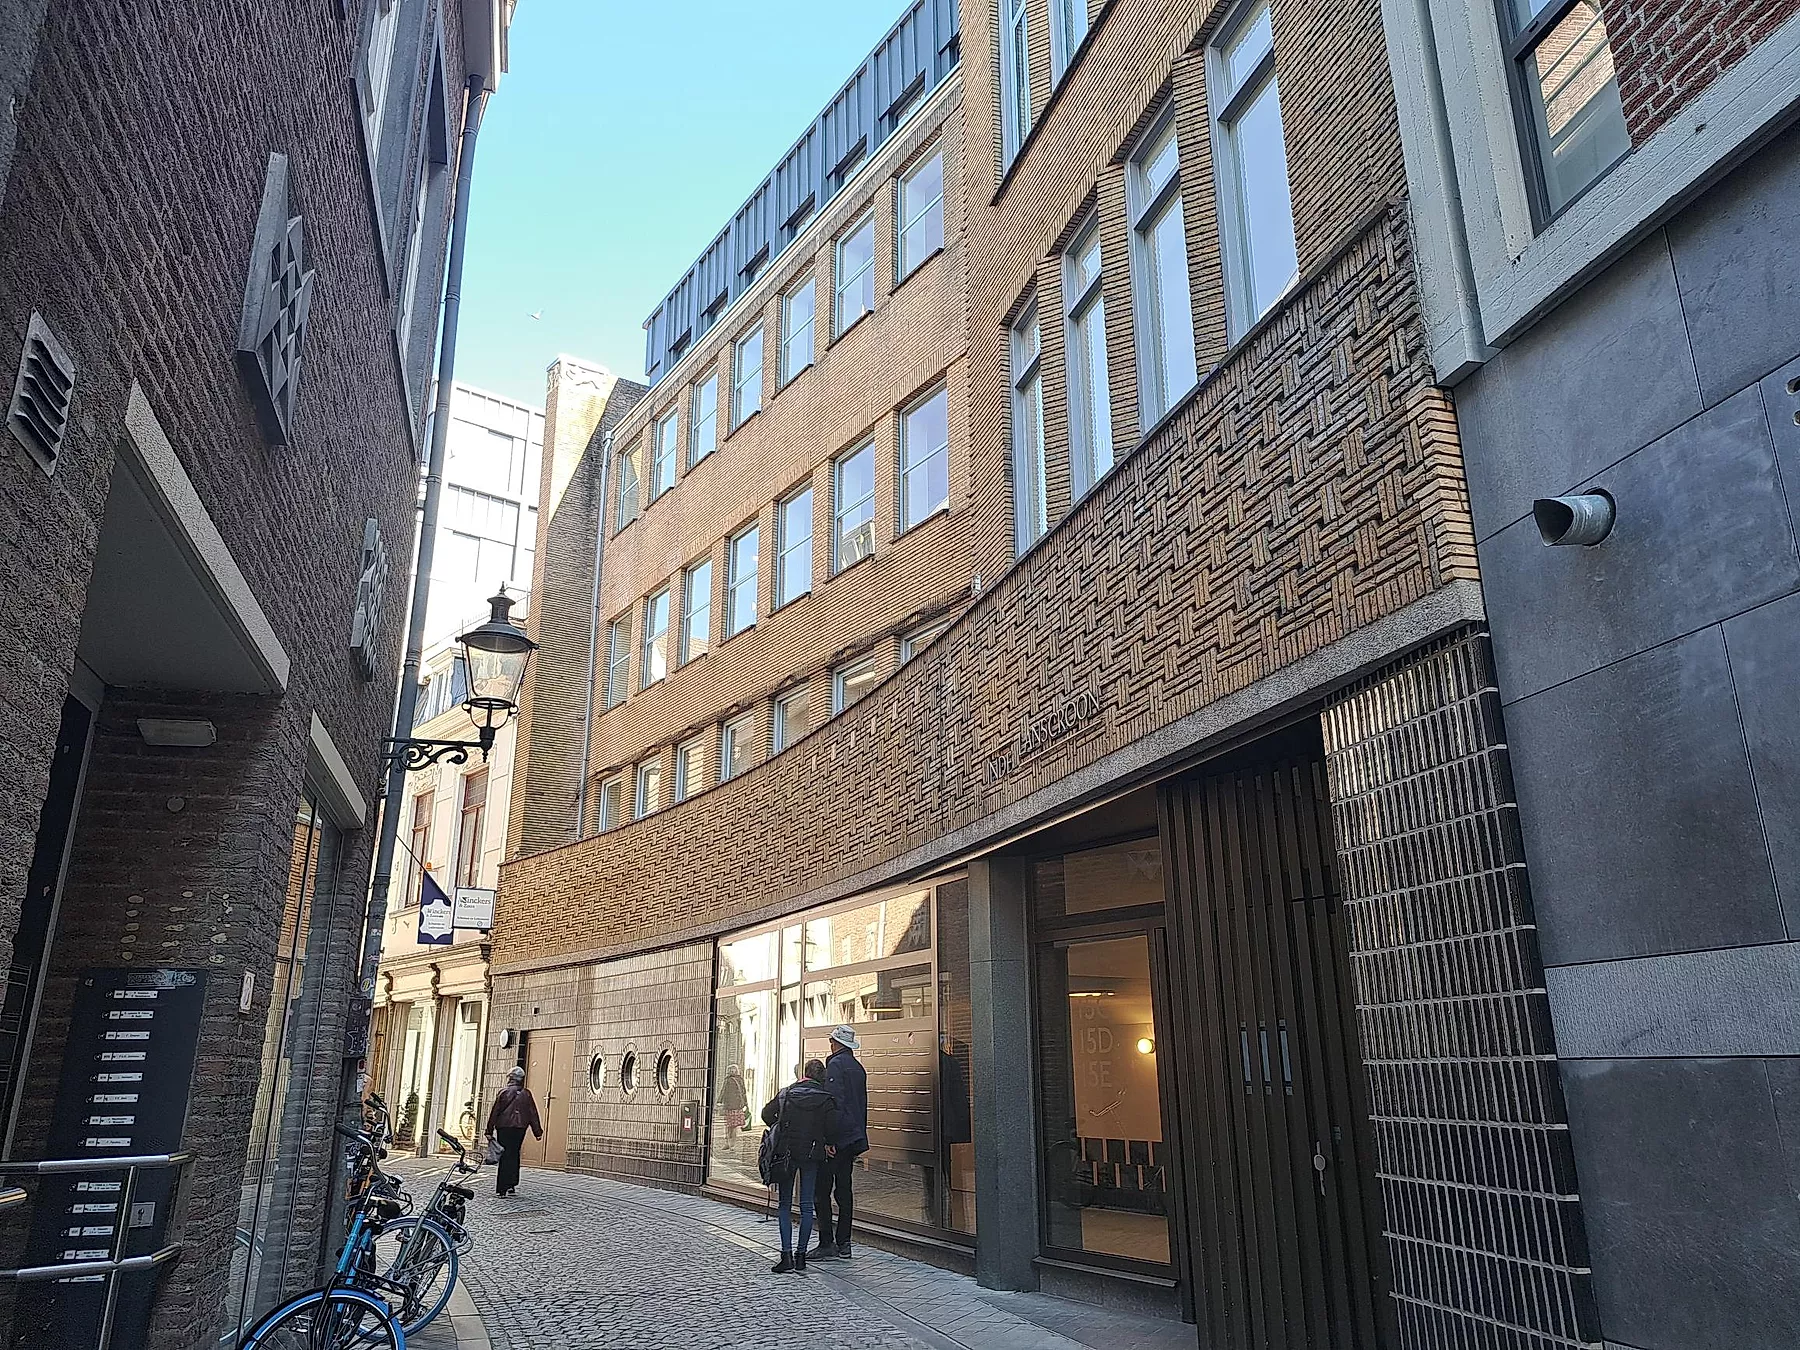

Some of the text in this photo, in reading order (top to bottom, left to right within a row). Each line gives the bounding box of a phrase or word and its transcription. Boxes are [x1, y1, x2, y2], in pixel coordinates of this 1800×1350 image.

[1019, 690, 1101, 756] LANSCROON
[1079, 1027, 1114, 1055] 15D
[1081, 1060, 1113, 1089] 15E
